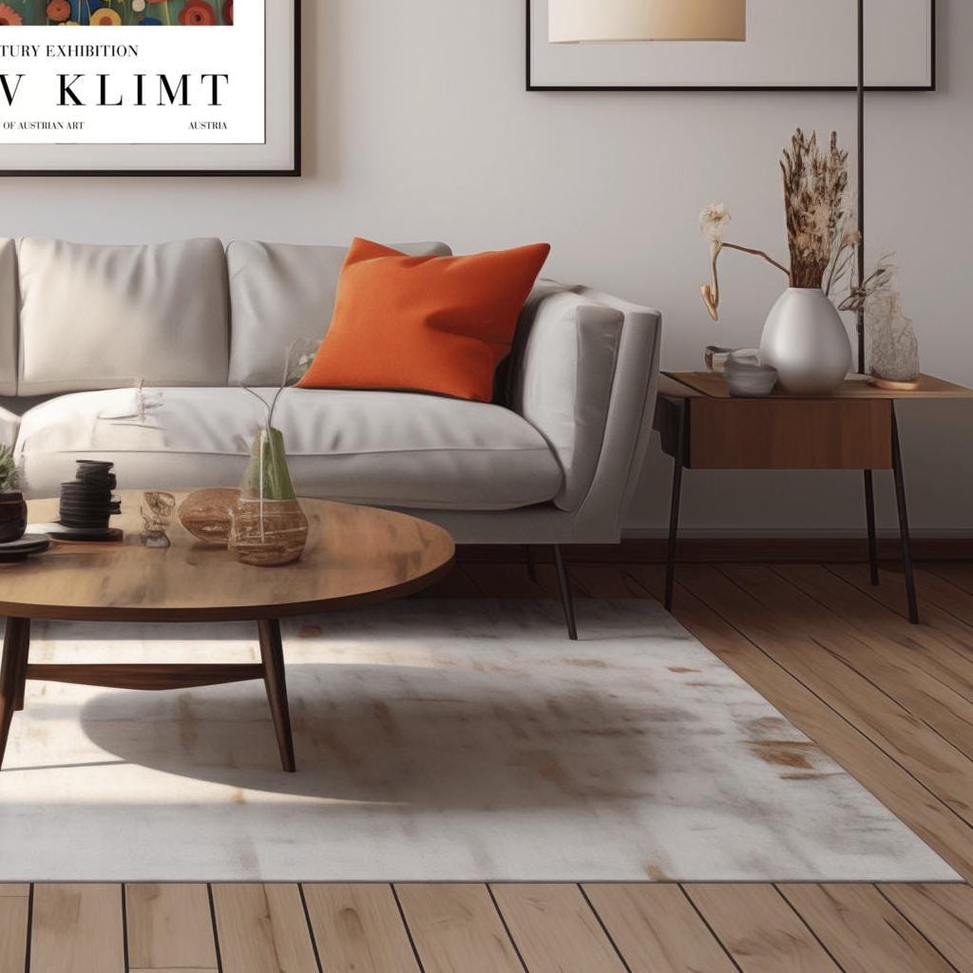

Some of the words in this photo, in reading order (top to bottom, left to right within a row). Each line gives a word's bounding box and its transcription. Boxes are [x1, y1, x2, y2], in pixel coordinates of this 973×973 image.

[45, 44, 139, 58] EXHIBITION
[56, 73, 229, 107] KLIMT
[2, 121, 15, 130] OF
[17, 121, 64, 130] AUSTRIAN
[66, 121, 84, 130] ART
[188, 121, 228, 130] AUSTRIA
